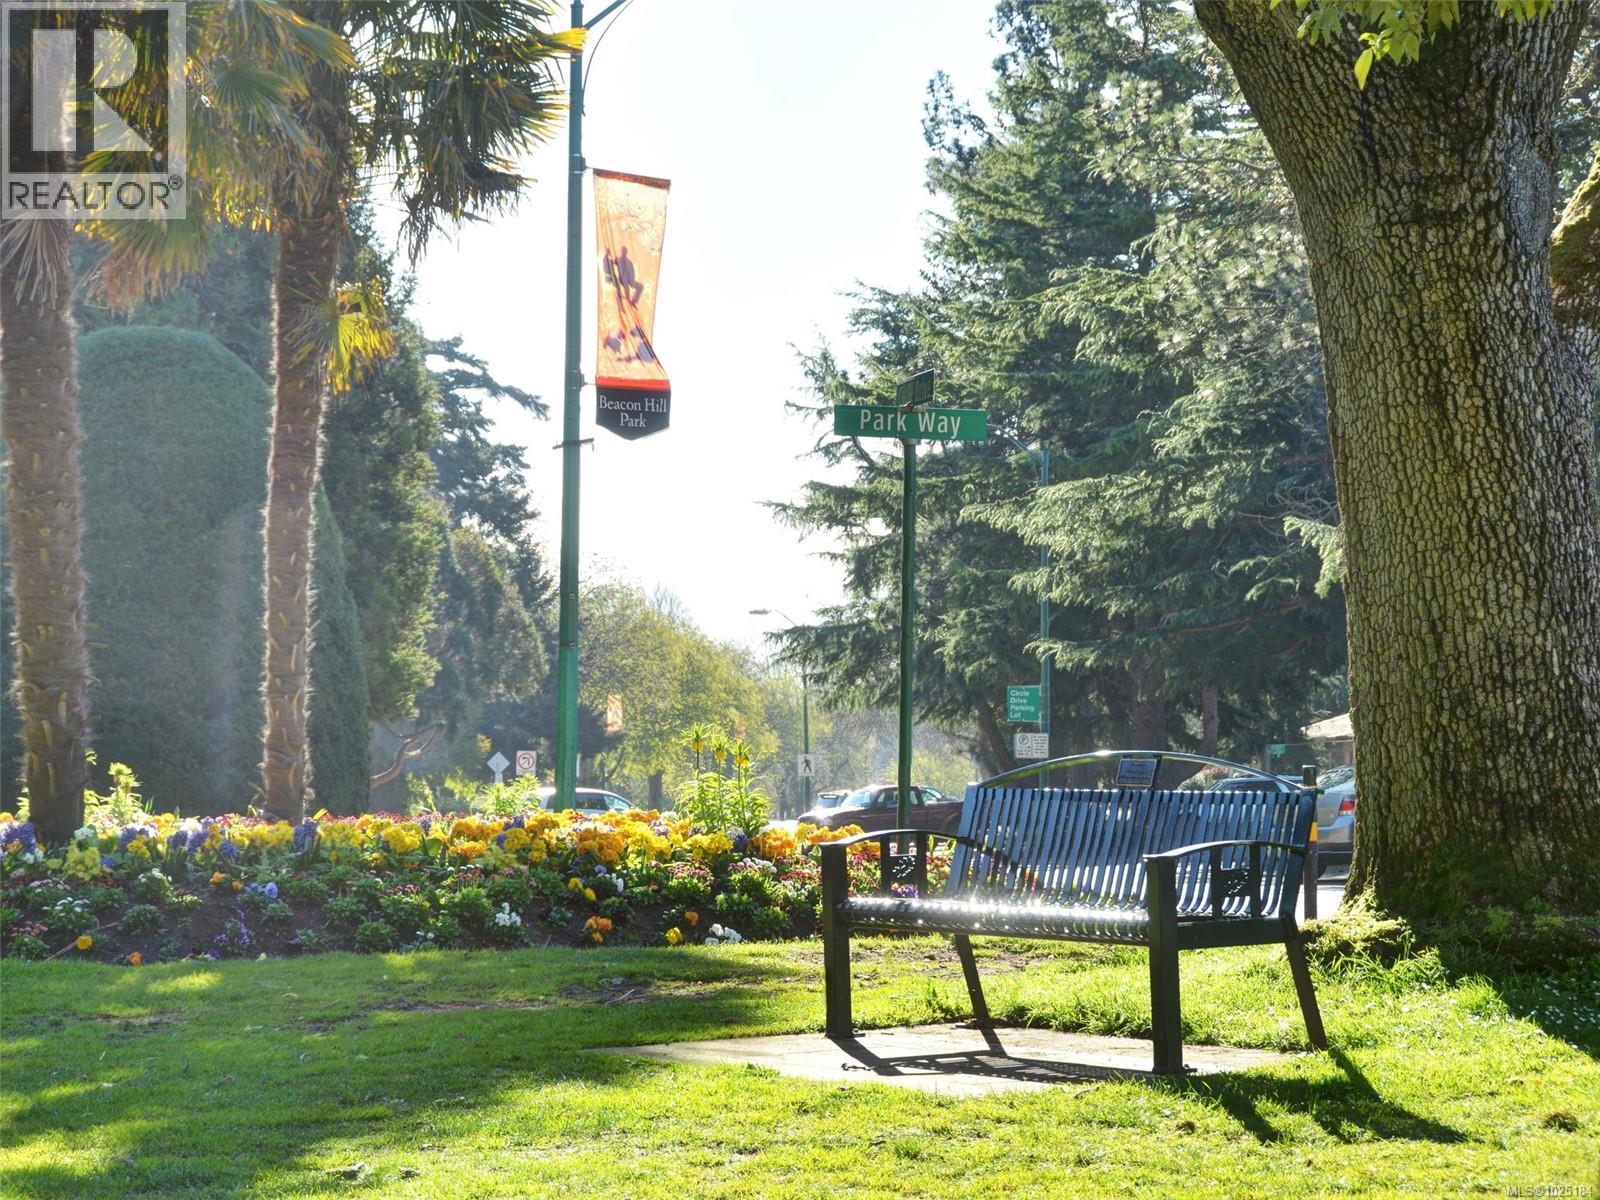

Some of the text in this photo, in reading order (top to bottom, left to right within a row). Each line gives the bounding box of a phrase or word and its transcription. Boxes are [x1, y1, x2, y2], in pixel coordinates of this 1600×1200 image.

[599, 394, 667, 412] Beacon Hill
[619, 412, 647, 428] Park
[859, 408, 961, 440] Park Way
[1009, 689, 1030, 697] Circle
[1010, 704, 1036, 713] Parking
[1010, 711, 1022, 719] Lot
